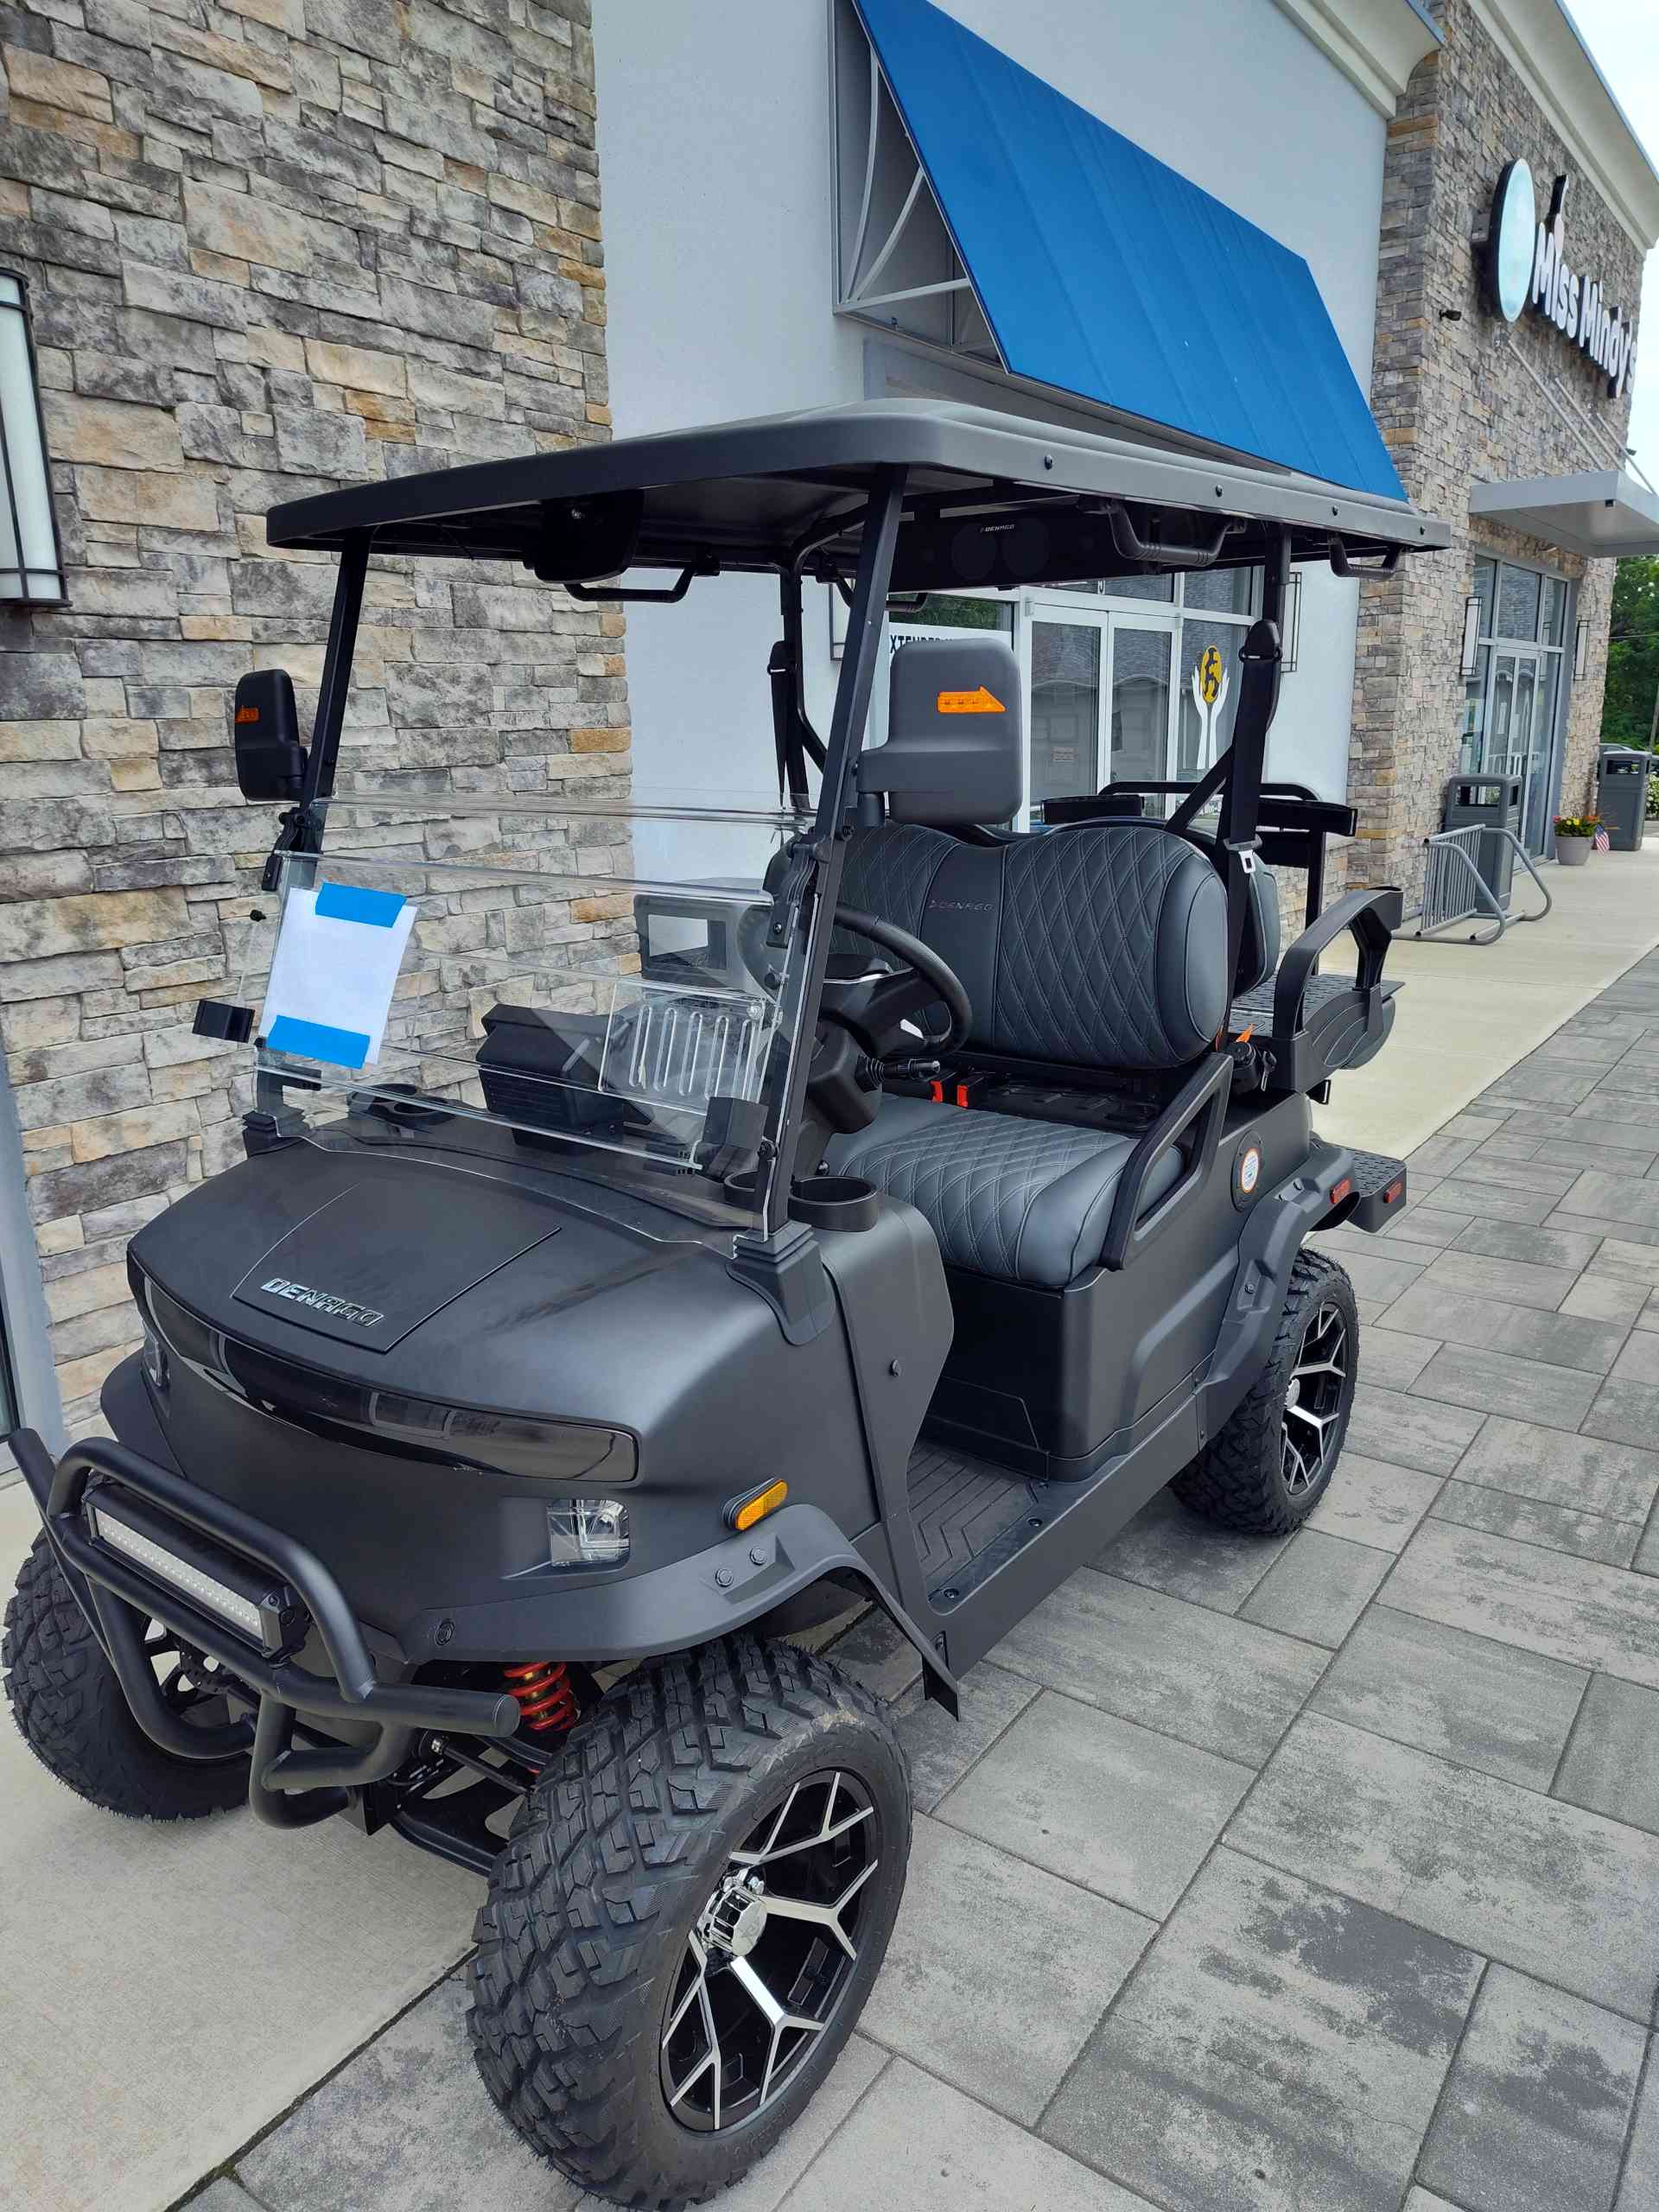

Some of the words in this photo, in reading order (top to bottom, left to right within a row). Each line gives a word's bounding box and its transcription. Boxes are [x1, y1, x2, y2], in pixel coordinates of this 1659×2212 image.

[1531, 219, 1580, 340] Miss
[1579, 274, 1638, 398] Mindy's
[260, 1277, 385, 1327] DENAGO
